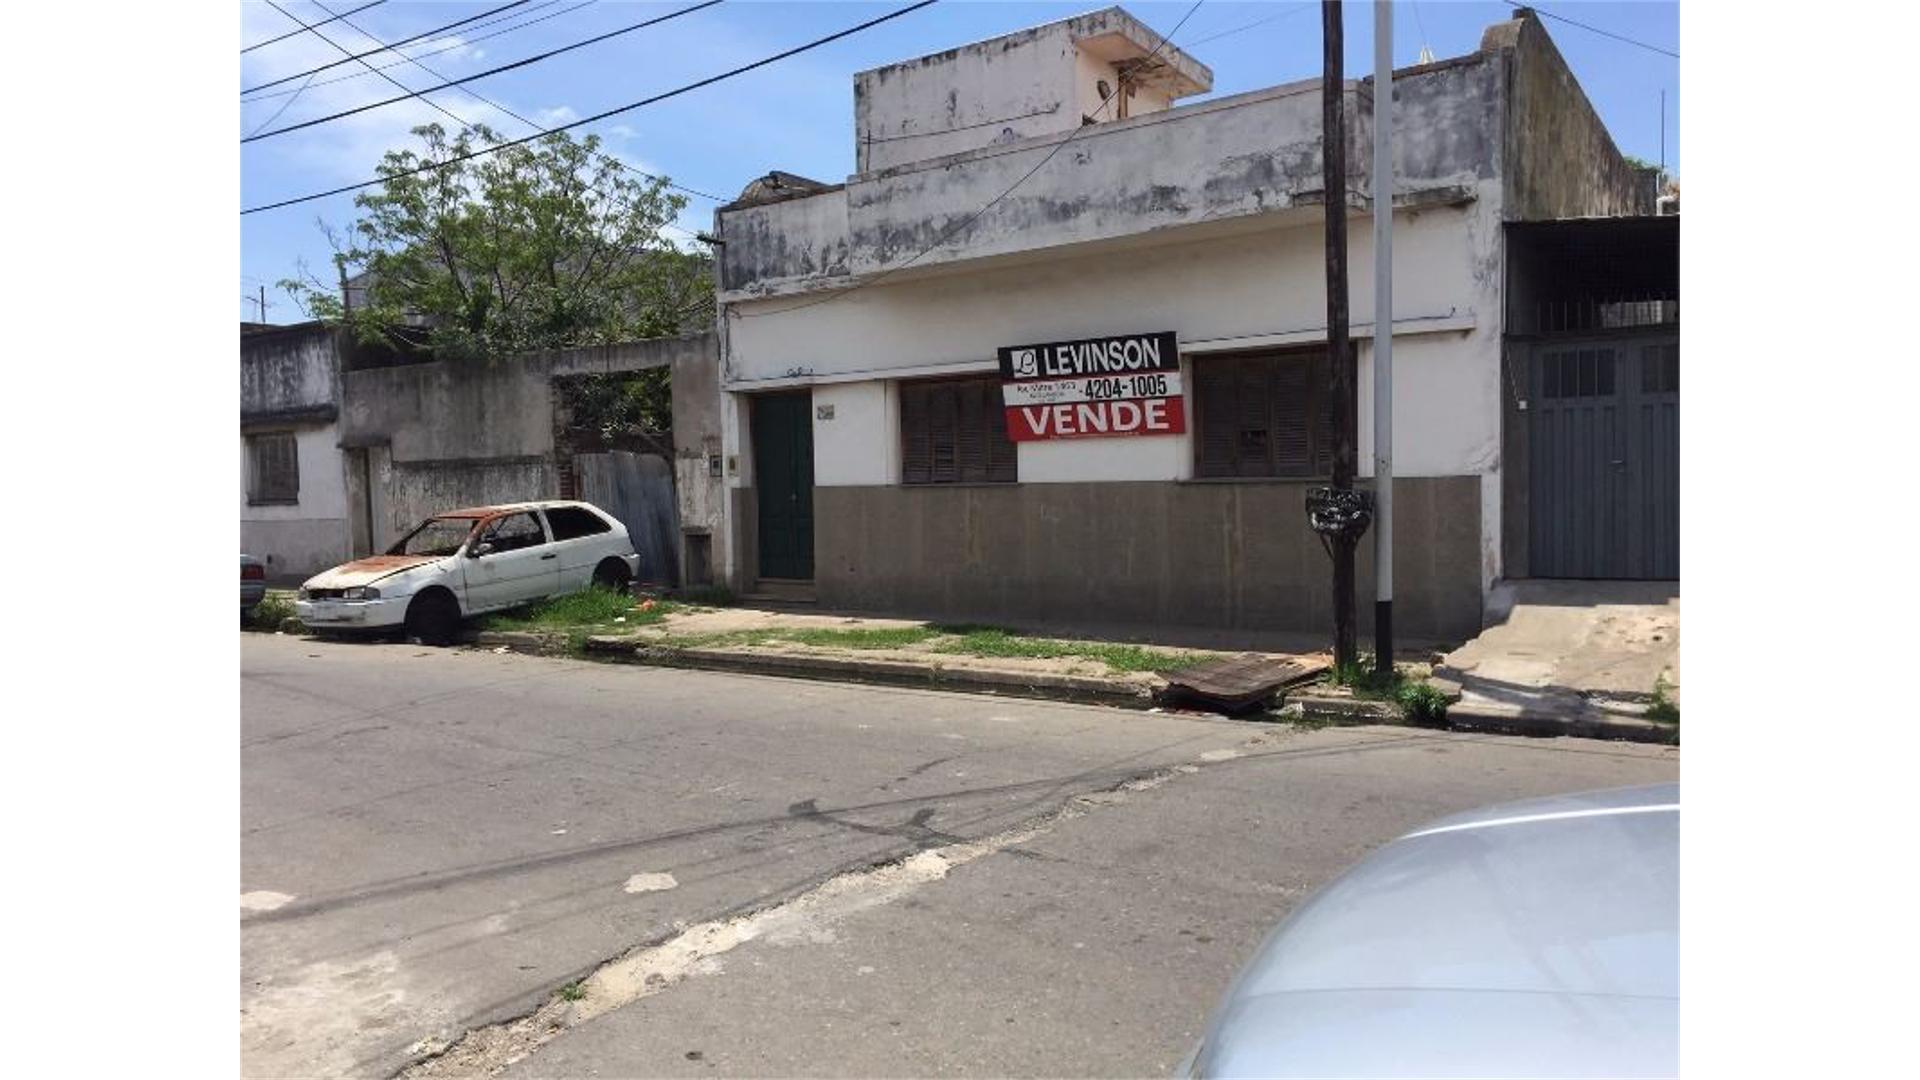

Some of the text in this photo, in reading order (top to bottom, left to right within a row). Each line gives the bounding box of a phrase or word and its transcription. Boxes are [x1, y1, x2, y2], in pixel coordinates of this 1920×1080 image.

[1044, 338, 1161, 375] LEVINSON
[1085, 375, 1167, 399] 4204-1005
[1022, 399, 1170, 435] VENDE
